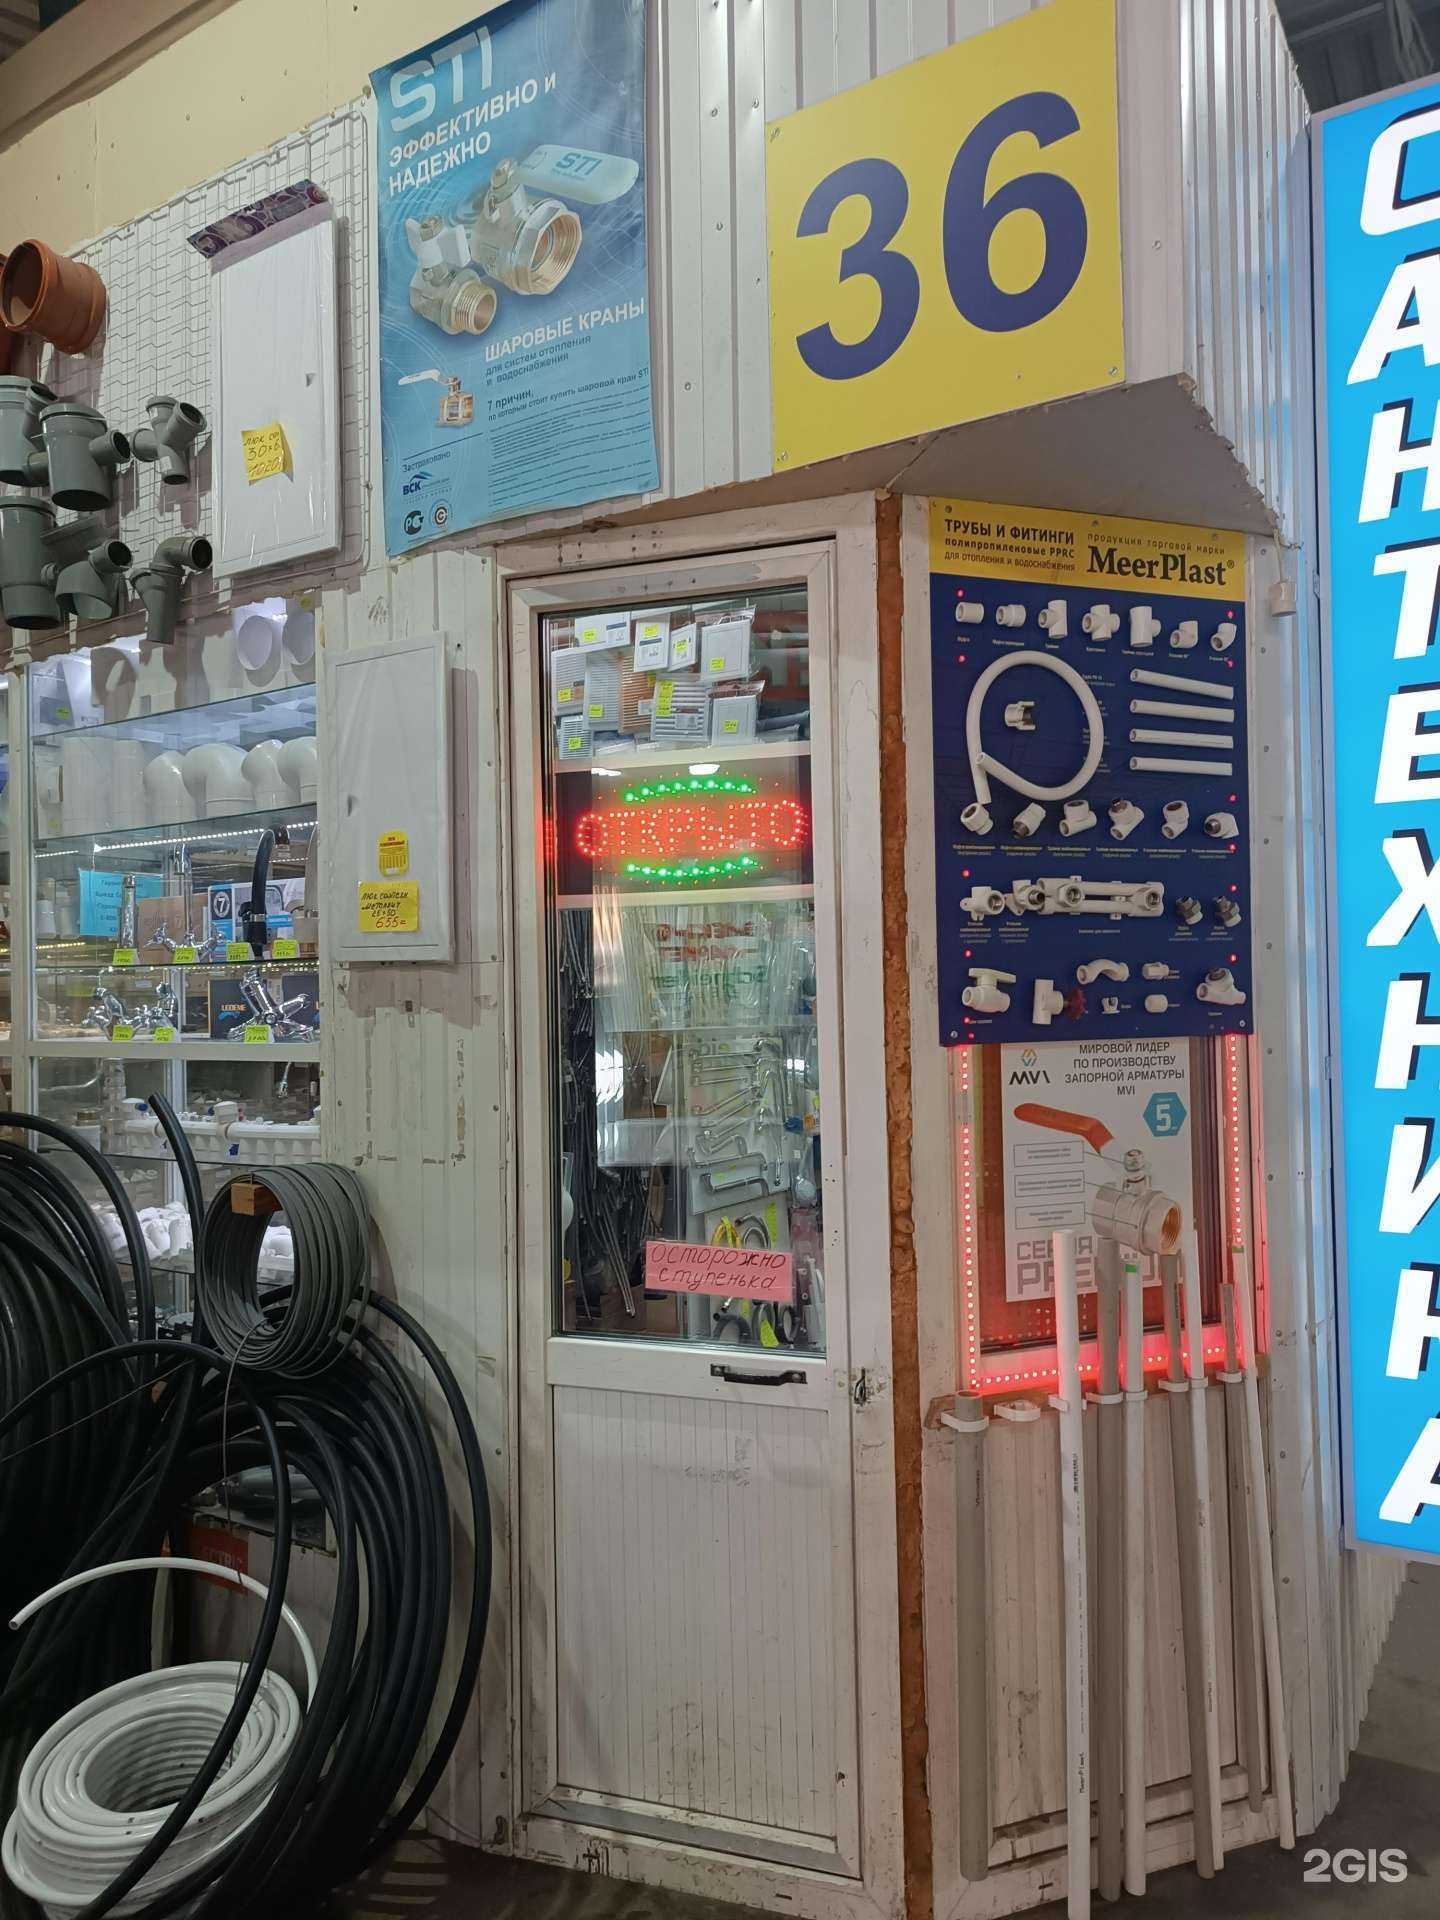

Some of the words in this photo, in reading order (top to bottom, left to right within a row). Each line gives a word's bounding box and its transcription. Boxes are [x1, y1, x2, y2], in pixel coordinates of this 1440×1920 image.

[389, 25, 493, 132] STI
[388, 78, 538, 169] ЭФФЕКТИВНО
[388, 131, 492, 197] НАДЕЖНО
[555, 151, 603, 176] STI
[795, 90, 1088, 381] 36
[485, 316, 573, 363] ШАРОВЫЕ
[578, 297, 645, 331] КРАНЫ
[944, 518, 992, 537] ТРУБЫ
[996, 524, 1006, 538] И
[1010, 526, 1075, 546] ФИТИНГИ
[944, 538, 1046, 557] полипропиленовые
[1086, 545, 1227, 586] MeerPlast
[576, 799, 804, 857] ОТКРЫТО
[1073, 1058, 1090, 1069] ПО
[1092, 1055, 1176, 1068] ПРОИЗВОДСТВУ
[1079, 1041, 1133, 1055] МИРОВОЙ
[1135, 1041, 1170, 1054] ЛИДЕР
[1064, 1069, 1124, 1084] ЗАПОРНОЙ
[1127, 1069, 1185, 1082] АРМАТУРЫ
[1116, 1086, 1136, 1096] MVI
[1155, 1103, 1173, 1132] 5
[1016, 1235, 1093, 1261] СЕЯ
[658, 1267, 777, 1291] ступенька
